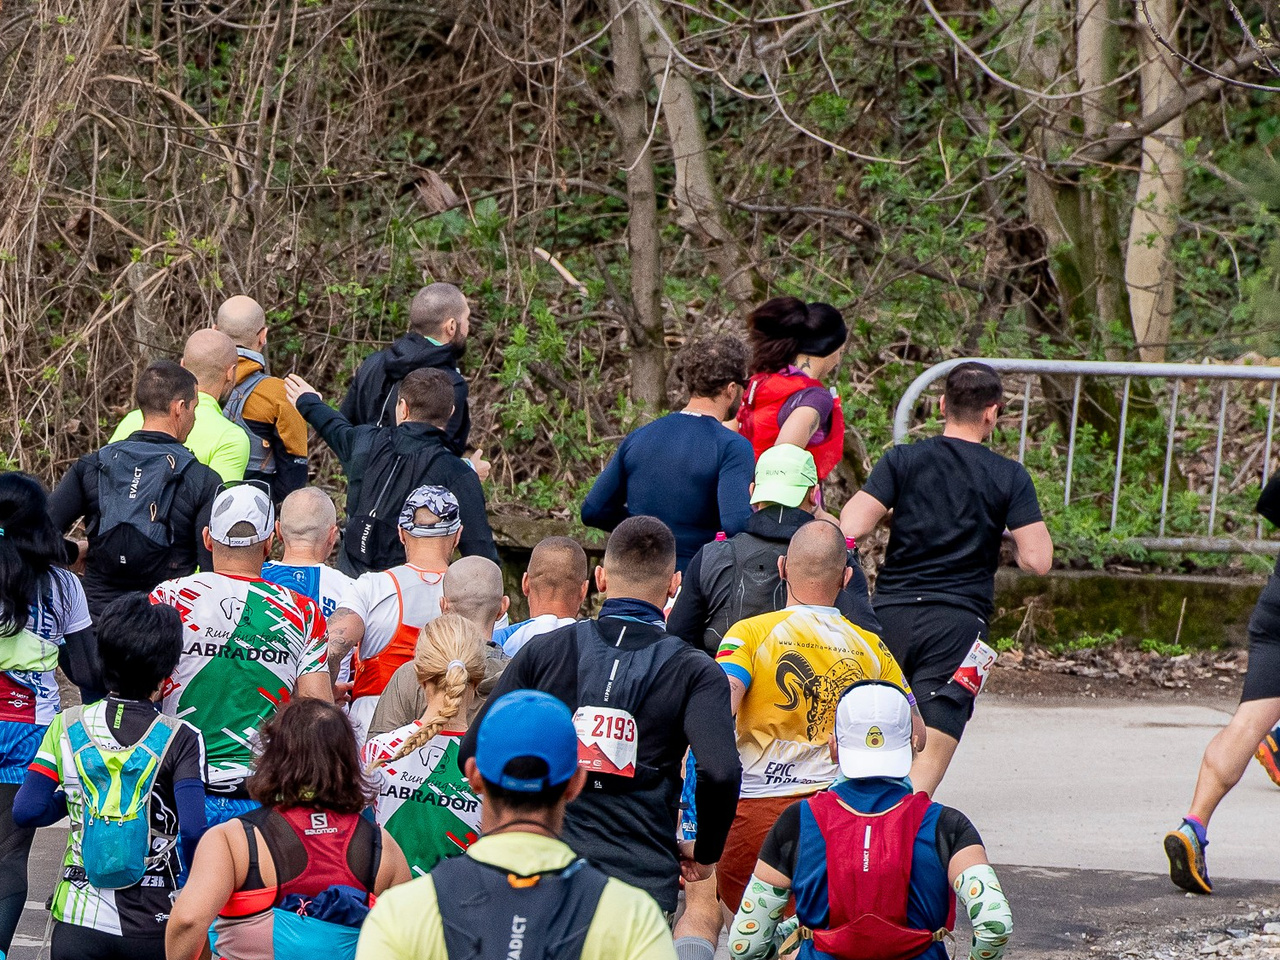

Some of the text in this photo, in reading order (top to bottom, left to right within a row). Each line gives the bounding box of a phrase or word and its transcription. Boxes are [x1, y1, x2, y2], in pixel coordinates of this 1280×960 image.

[128, 466, 143, 499] EVADICT
[360, 523, 372, 554] KIPRUN
[591, 714, 635, 742] 2193
[764, 761, 796, 777] EPIC
